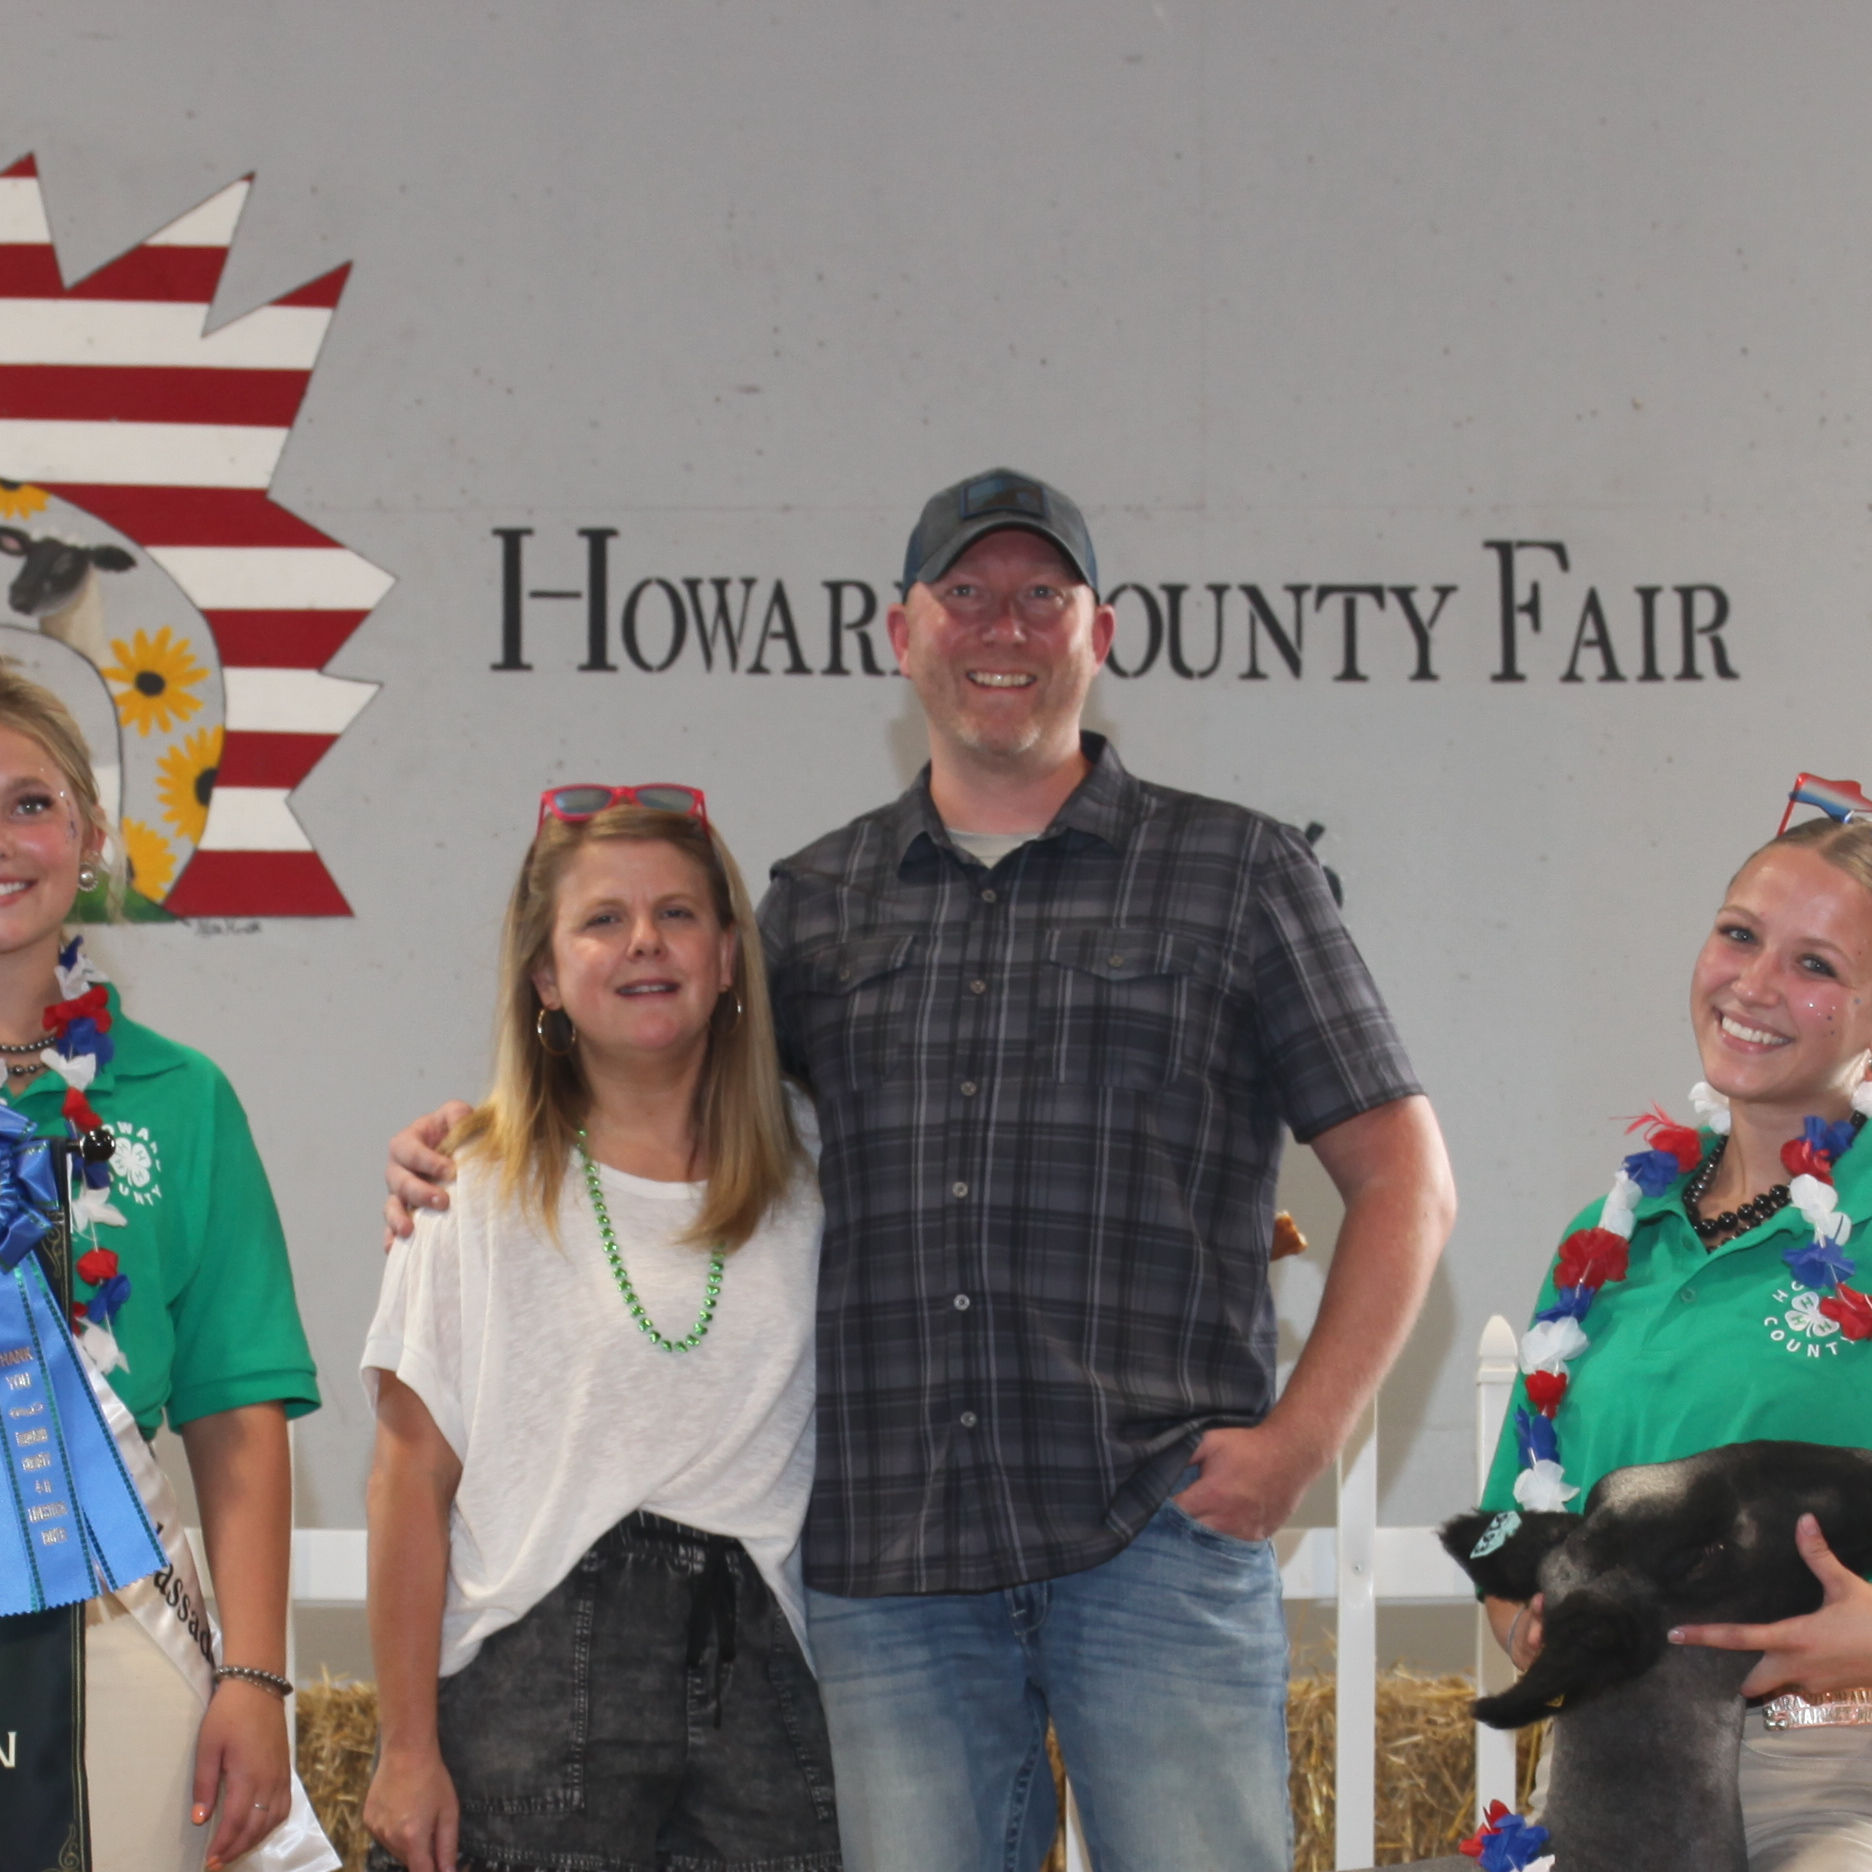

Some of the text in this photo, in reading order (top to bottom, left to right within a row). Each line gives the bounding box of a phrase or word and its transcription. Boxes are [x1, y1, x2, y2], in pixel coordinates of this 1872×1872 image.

[490, 527, 1740, 682] HOWAR OUNTY FAIR
